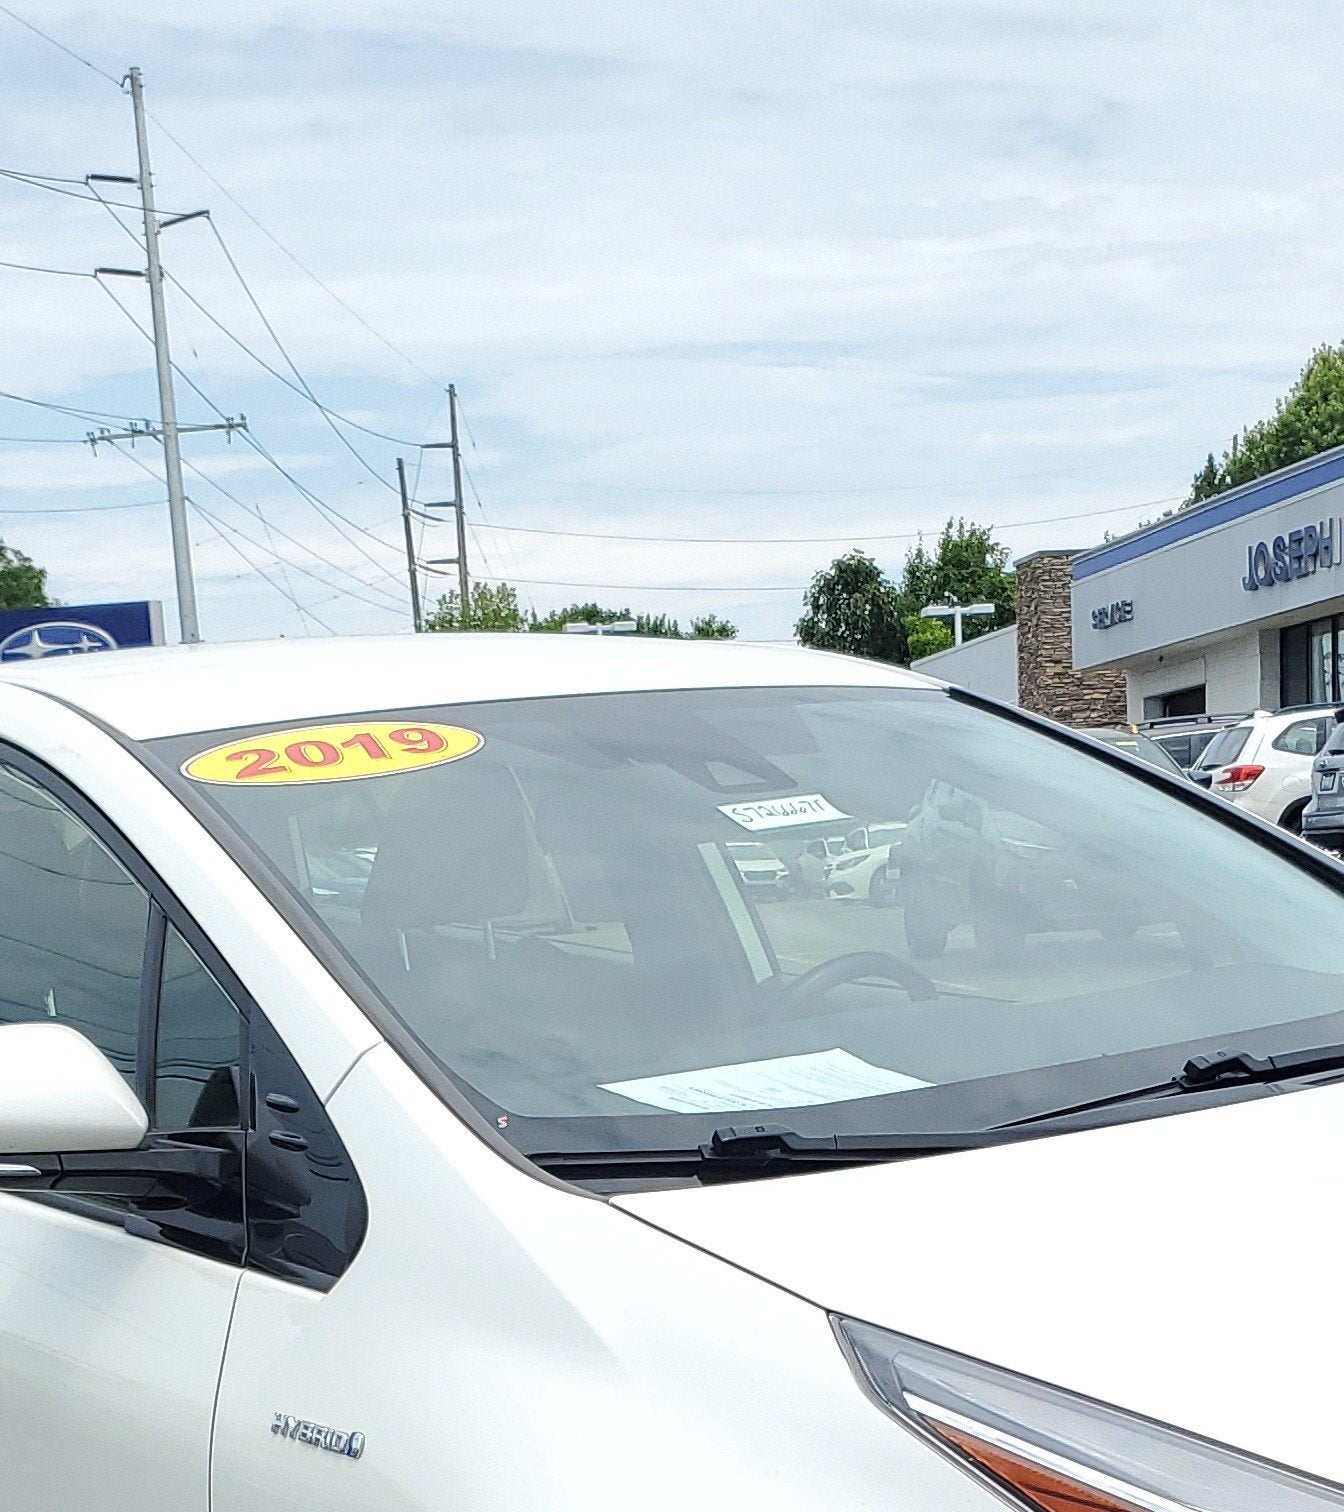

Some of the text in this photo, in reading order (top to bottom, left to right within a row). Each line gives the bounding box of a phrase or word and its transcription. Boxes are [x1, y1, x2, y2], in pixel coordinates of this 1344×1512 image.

[1241, 517, 1342, 592] JOSEPH
[226, 727, 447, 780] 2019
[271, 1412, 350, 1455] HYBRID
